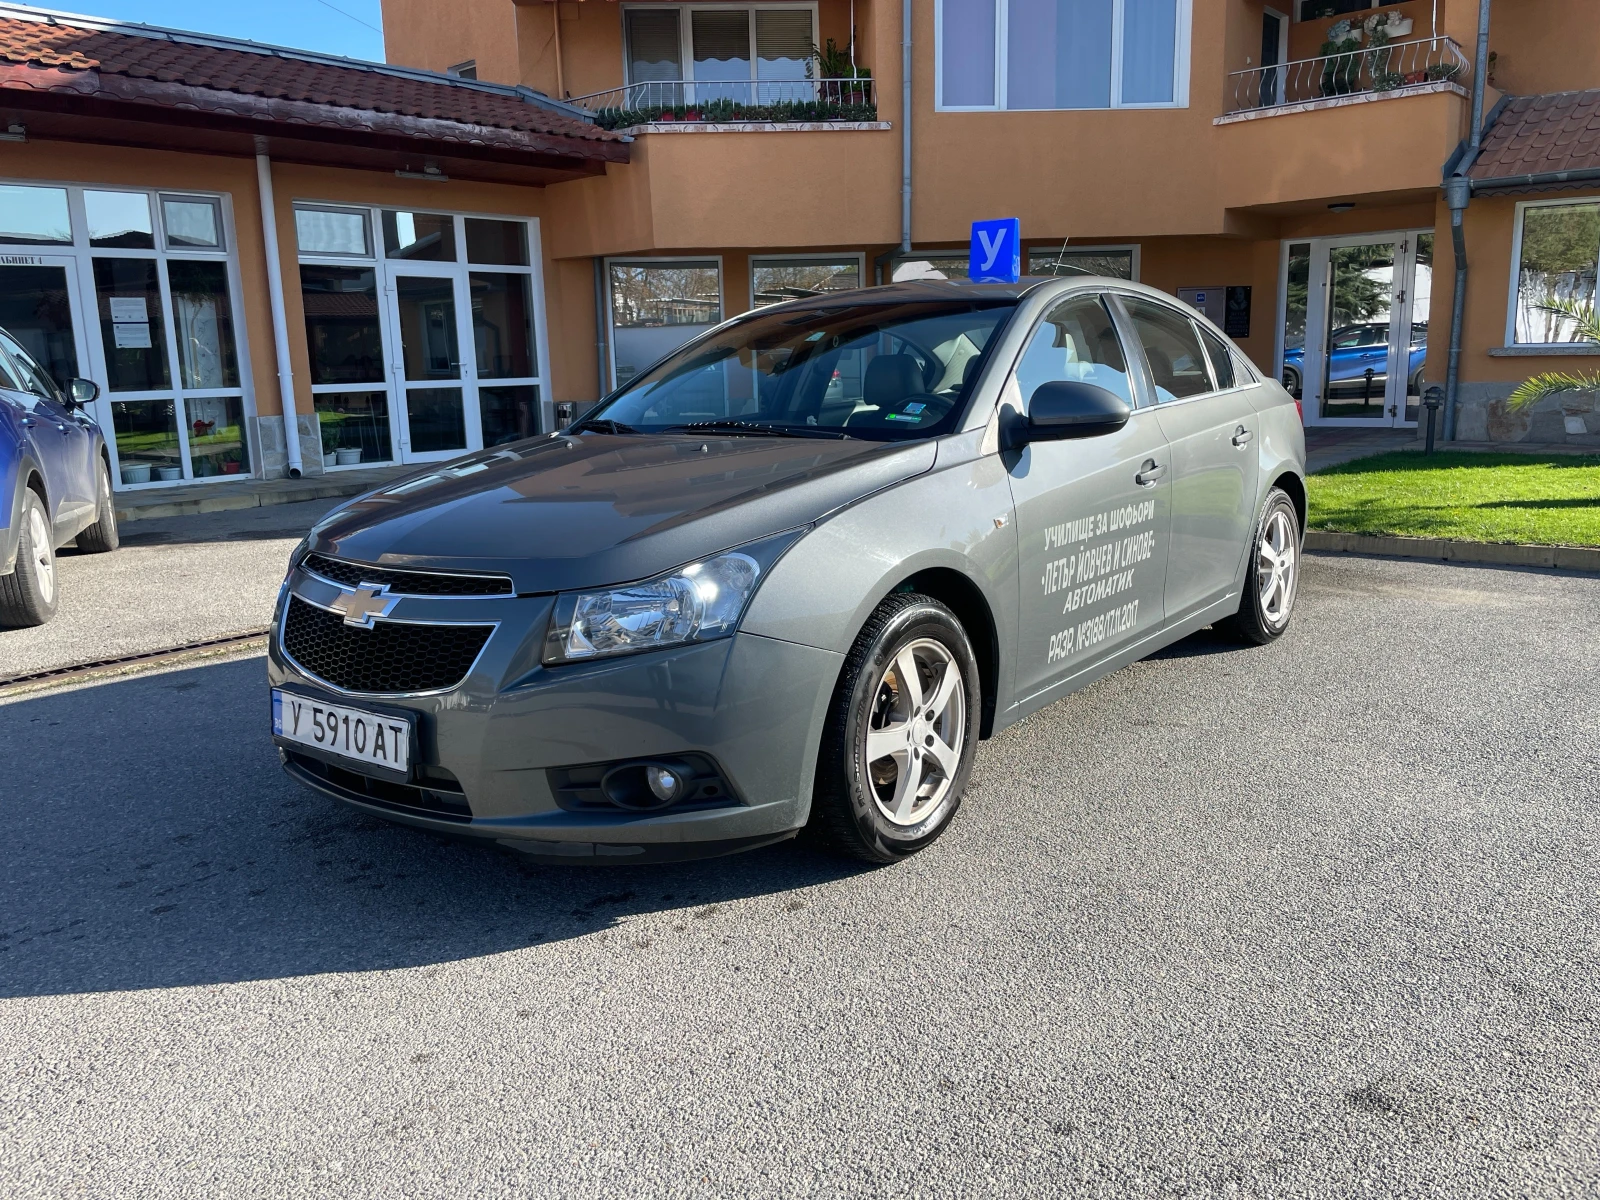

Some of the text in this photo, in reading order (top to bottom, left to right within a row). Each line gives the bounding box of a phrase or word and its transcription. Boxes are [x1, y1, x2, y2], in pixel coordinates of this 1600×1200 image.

[1044, 500, 1154, 550] УЧИЛИЩЕ ЗА ШОФЬОРИ
[1077, 543, 1112, 584] ЙОВЧЕВ
[1113, 541, 1121, 571] И
[1063, 568, 1135, 614] АВТОМАТИК
[1048, 627, 1074, 663] РАЗР.
